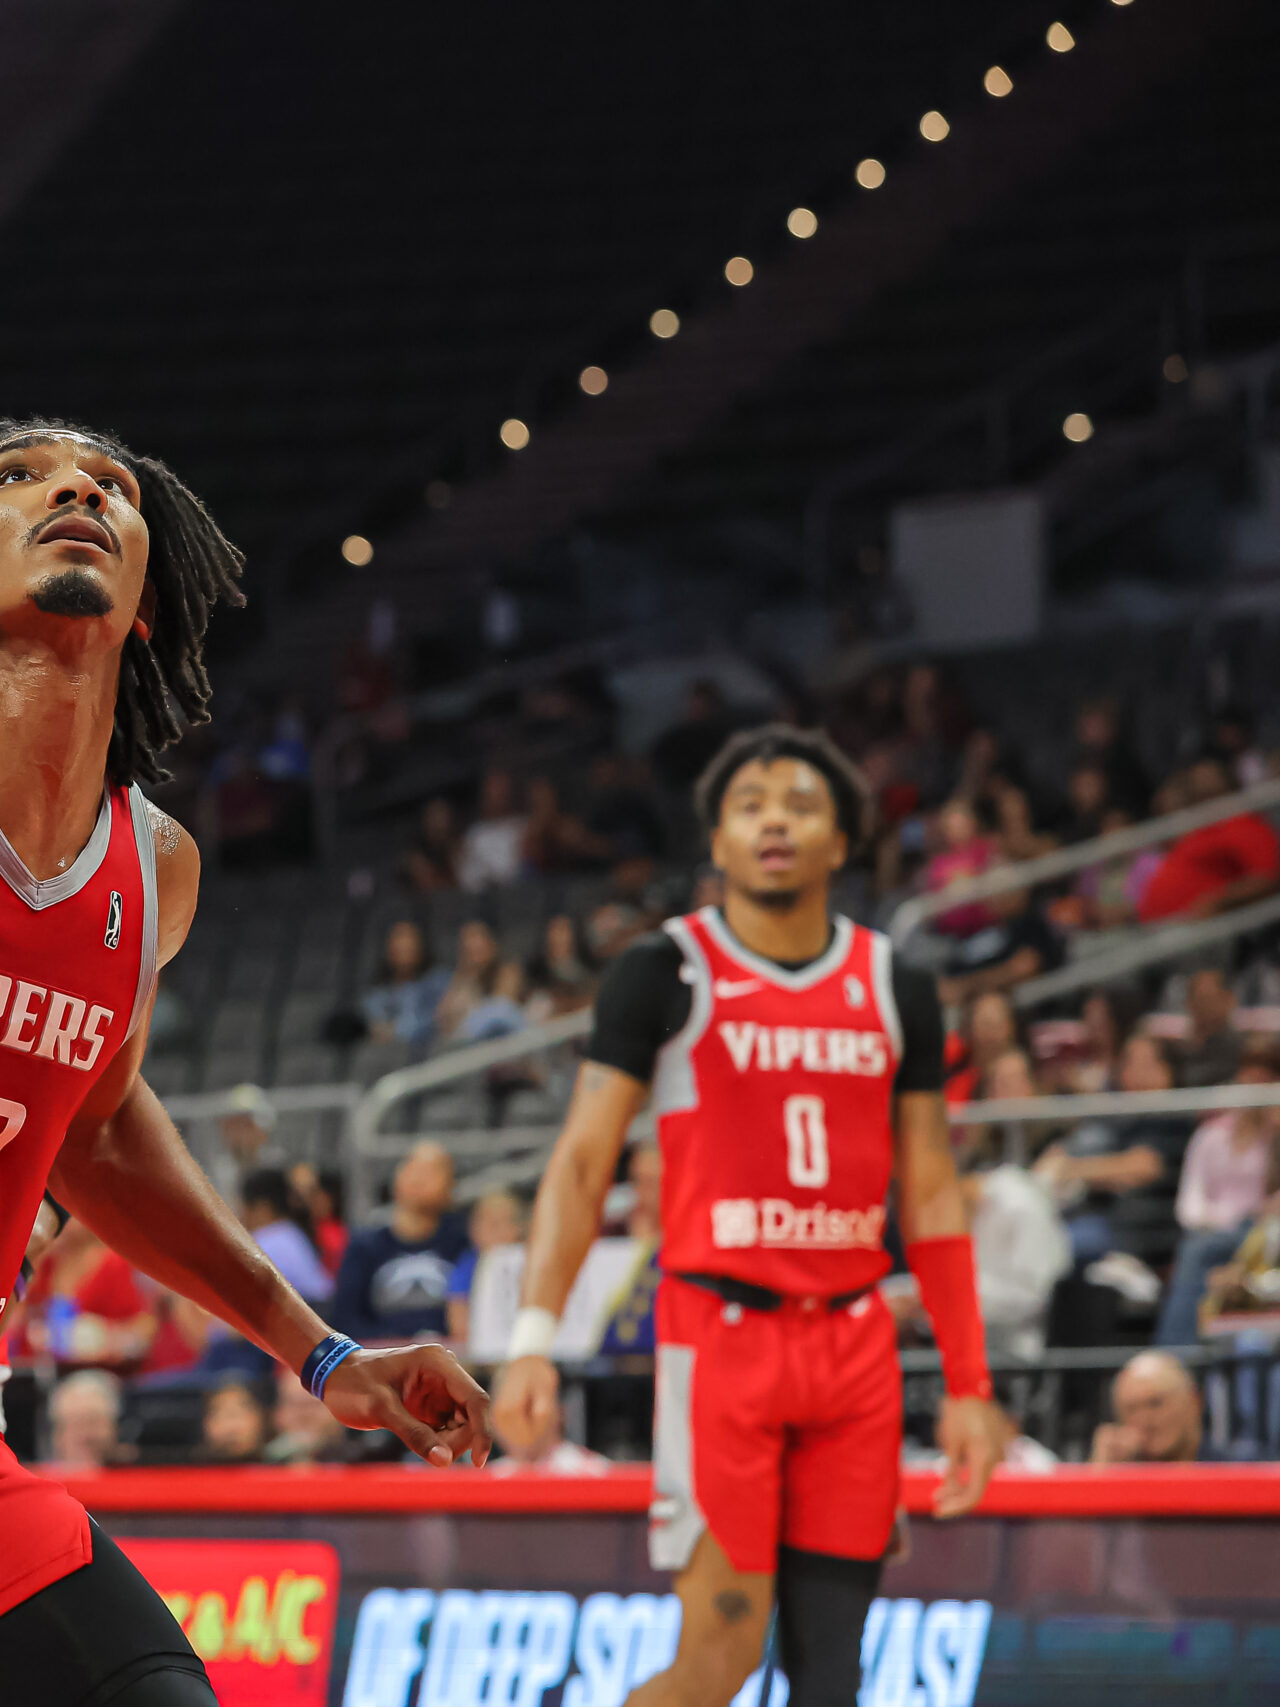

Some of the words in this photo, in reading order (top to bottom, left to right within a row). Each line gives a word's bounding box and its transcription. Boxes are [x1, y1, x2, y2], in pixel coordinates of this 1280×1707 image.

[718, 1021, 887, 1077] VIPERS
[783, 1094, 830, 1189] 0
[343, 1588, 435, 1707] OF
[417, 1588, 578, 1707] DEEP
